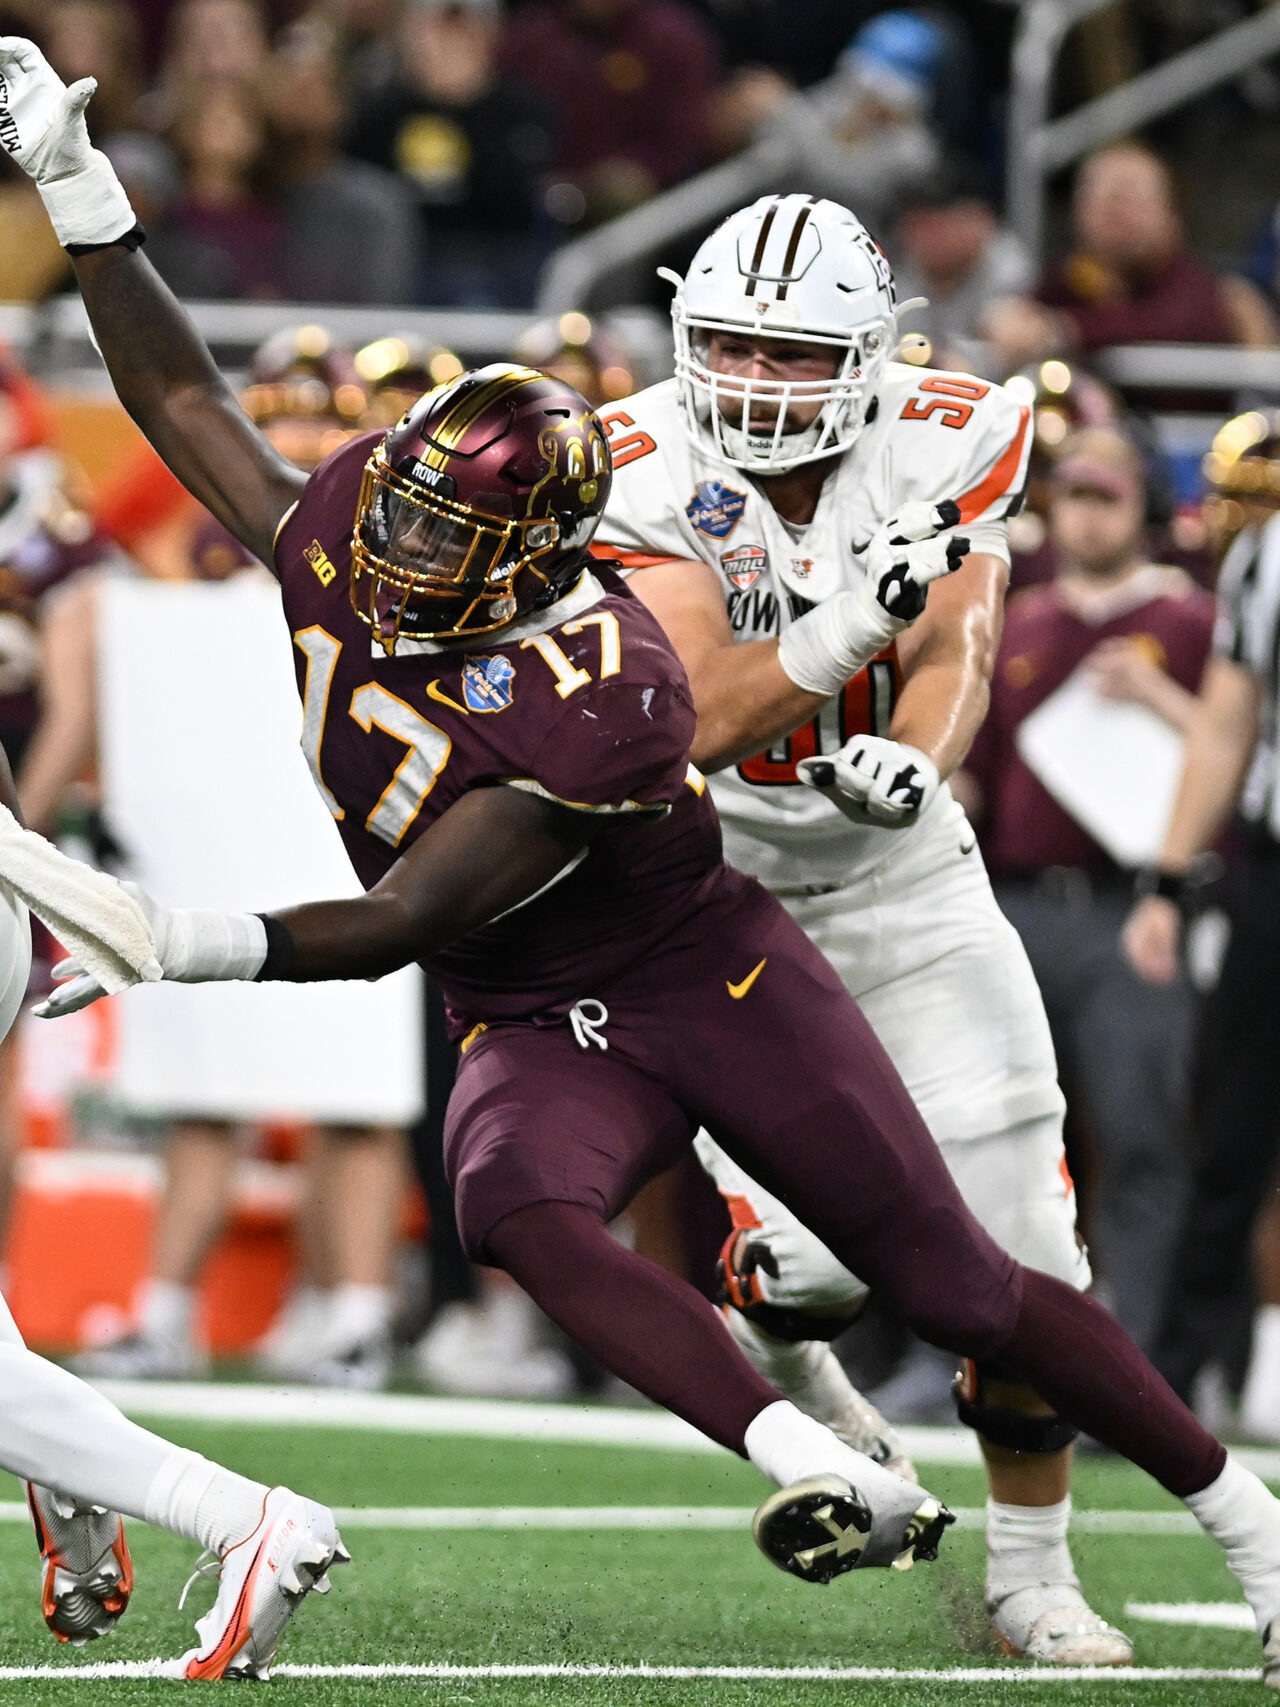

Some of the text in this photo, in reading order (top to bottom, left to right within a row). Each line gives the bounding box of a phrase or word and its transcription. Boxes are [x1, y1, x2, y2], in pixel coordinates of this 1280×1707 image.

[899, 376, 991, 430] 50
[411, 461, 444, 487] ROW
[520, 610, 621, 700] 17
[294, 624, 452, 848] 17
